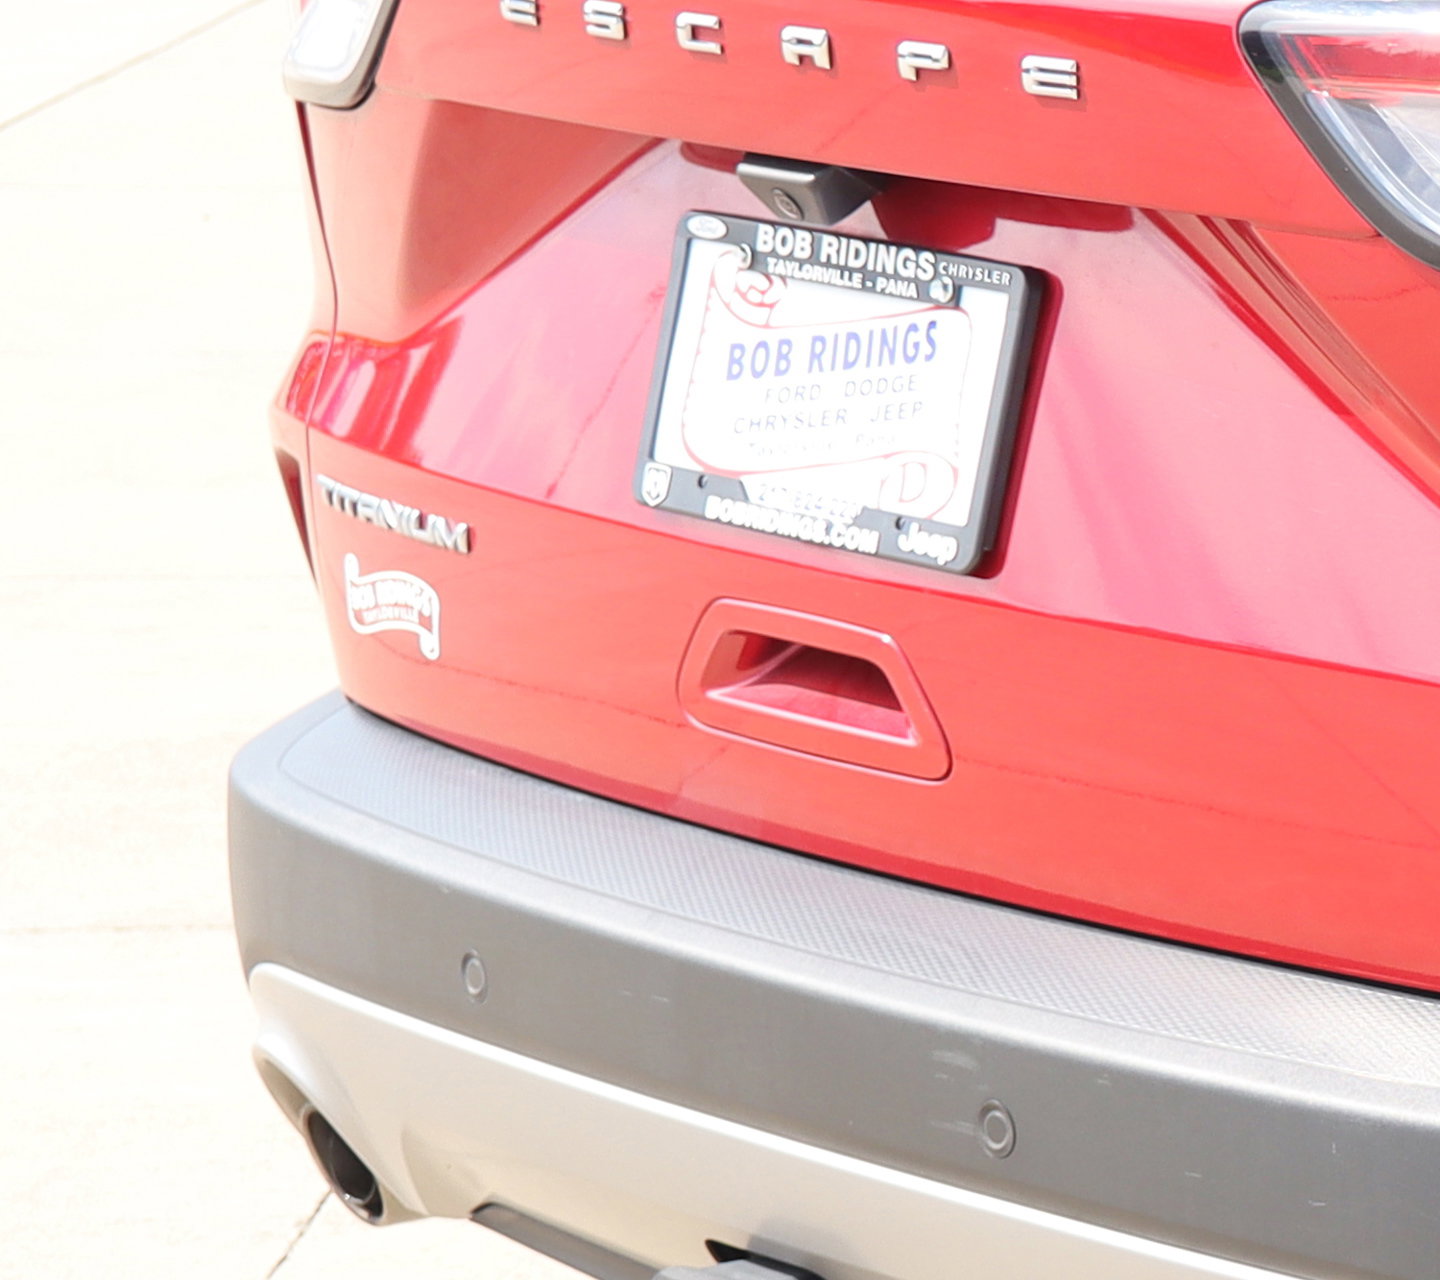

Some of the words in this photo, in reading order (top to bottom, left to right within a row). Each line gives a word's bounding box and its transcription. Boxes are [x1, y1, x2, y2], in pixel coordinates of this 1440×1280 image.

[756, 224, 812, 260] BOB
[820, 234, 937, 281] RIDINGS
[938, 261, 1012, 287] CHRYSLER
[766, 258, 863, 290] TAYLORVILLE
[876, 277, 918, 299] PANA
[726, 338, 793, 381] BOB
[808, 320, 938, 374] RIDINGS
[764, 383, 822, 405] FORD
[843, 374, 918, 399] DODGE
[733, 407, 848, 435] CHRYSLER
[869, 401, 924, 424] JEEP
[316, 474, 472, 555] TITANIUM
[704, 494, 880, 555] BOBRIDINGS.COM
[897, 520, 958, 566] Jeep
